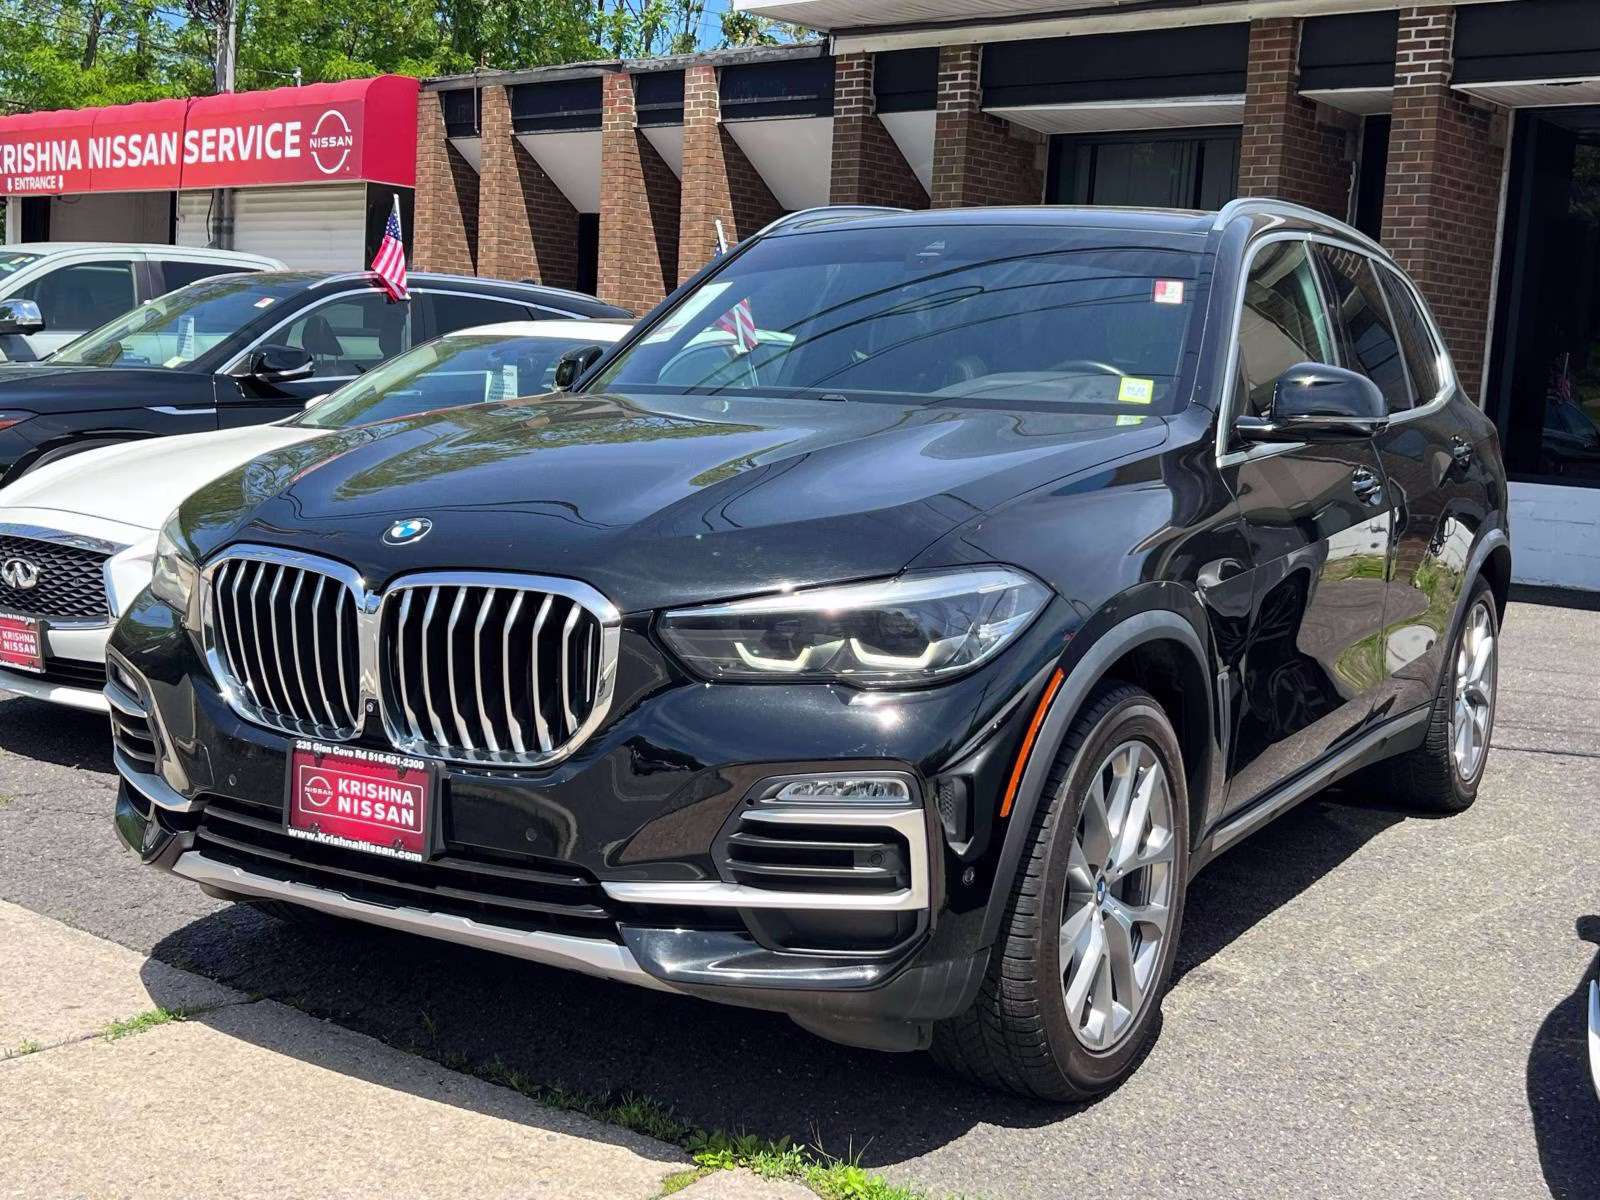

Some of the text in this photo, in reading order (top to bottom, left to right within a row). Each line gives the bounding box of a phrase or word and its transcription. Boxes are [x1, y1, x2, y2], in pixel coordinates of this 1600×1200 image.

[0, 121, 301, 174] RISHNA NISSAN SERVICE
[310, 135, 353, 148] NISSAN
[14, 175, 56, 191] ENTRANCE
[2, 630, 36, 644] KRISHNA
[3, 641, 36, 655] NISSAN
[296, 740, 425, 769] 235 Glen Cove Rd 516-621-2300
[304, 786, 333, 796] NISSAN
[338, 778, 414, 806] KRISHNA
[338, 796, 414, 826] NISSAN
[288, 828, 422, 862] www.KrishnaNissan.com
